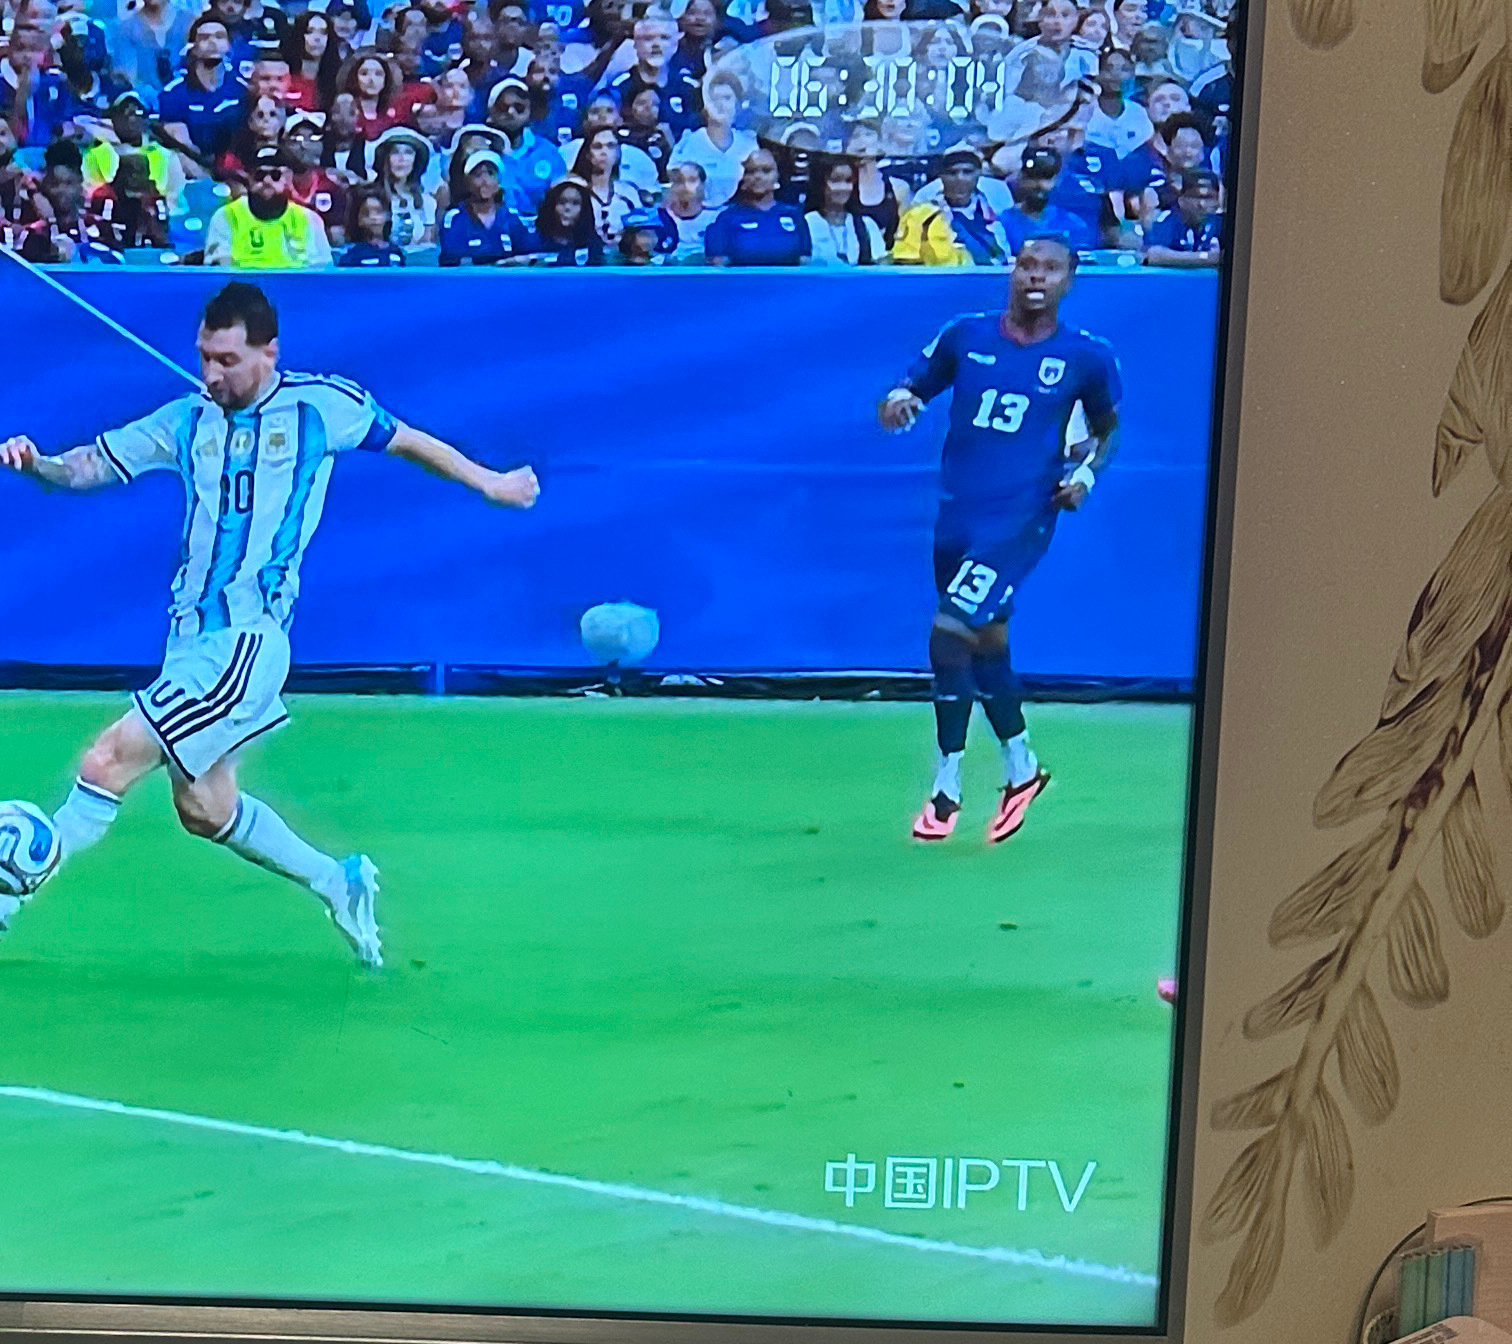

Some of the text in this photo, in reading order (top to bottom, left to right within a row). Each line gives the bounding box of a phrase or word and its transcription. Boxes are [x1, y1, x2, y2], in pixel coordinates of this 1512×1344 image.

[769, 56, 1006, 118] 06:30:04
[972, 388, 1030, 433] 13
[947, 560, 997, 605] 13
[824, 1153, 1097, 1213] 中国IPTV
